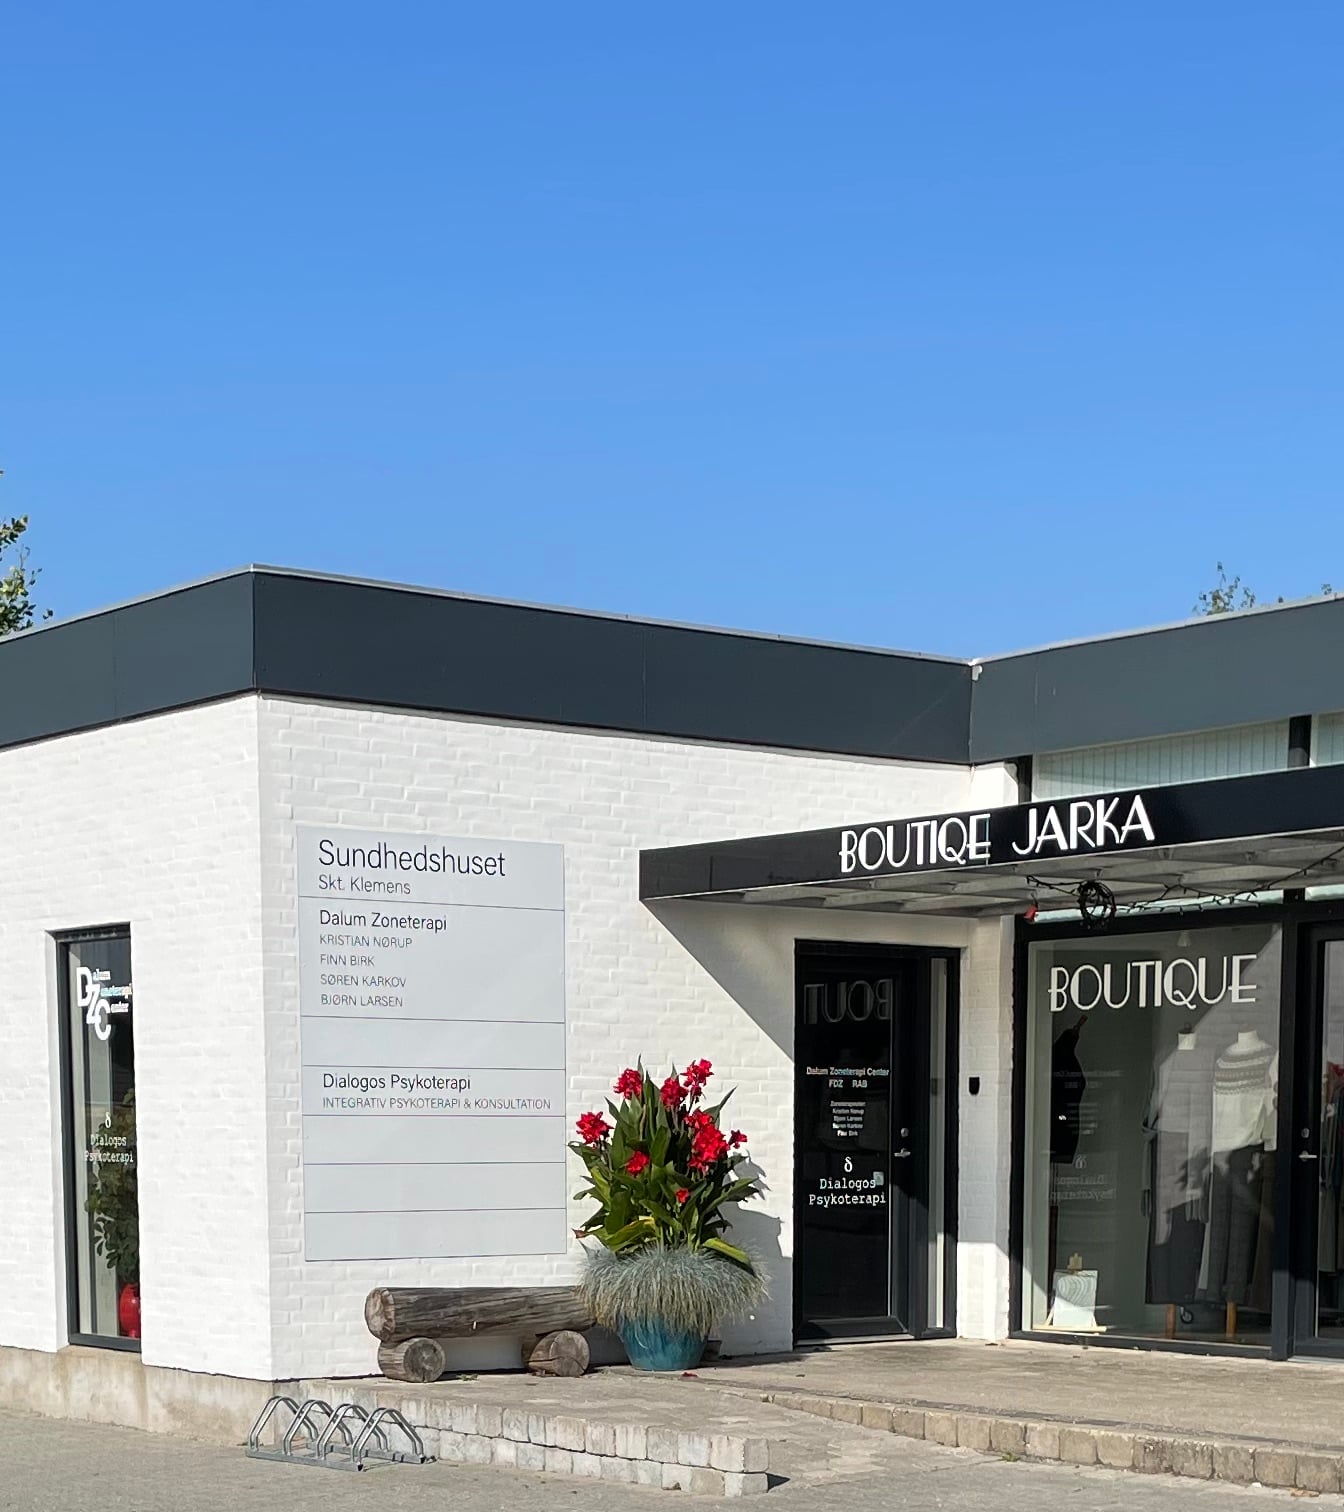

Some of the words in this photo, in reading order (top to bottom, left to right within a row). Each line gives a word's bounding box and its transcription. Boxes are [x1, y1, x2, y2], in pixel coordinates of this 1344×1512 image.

[838, 813, 992, 873] BOUTIQE
[1012, 794, 1156, 855] JARKA
[318, 839, 507, 877] Sundhedshuset
[318, 874, 345, 890] Skt.
[350, 876, 411, 895] Klemens
[319, 909, 367, 927] Dalum
[371, 912, 447, 934] Zoneterapi
[319, 934, 370, 946] KRISTIAN
[373, 936, 413, 949] NØRUP
[320, 954, 347, 966] FINN
[350, 955, 375, 967] BIRK
[320, 974, 359, 986] SØREN
[362, 976, 407, 988] KARKOV
[1048, 954, 1258, 1012] BOUTIQUE
[321, 994, 357, 1006] BJØRN
[360, 995, 403, 1007] LARSEN
[323, 1073, 386, 1092] Dialogos
[390, 1074, 471, 1093] Psykoterapi
[322, 1097, 387, 1109] INTEGRATIV
[389, 1098, 461, 1109] PSYKOTERAPI
[463, 1098, 472, 1109] &
[474, 1098, 551, 1110] KONSULTATION
[90, 1134, 127, 1148] Dialogos
[819, 1177, 876, 1192] Dialogos
[809, 1192, 887, 1209] Psykoterapi
